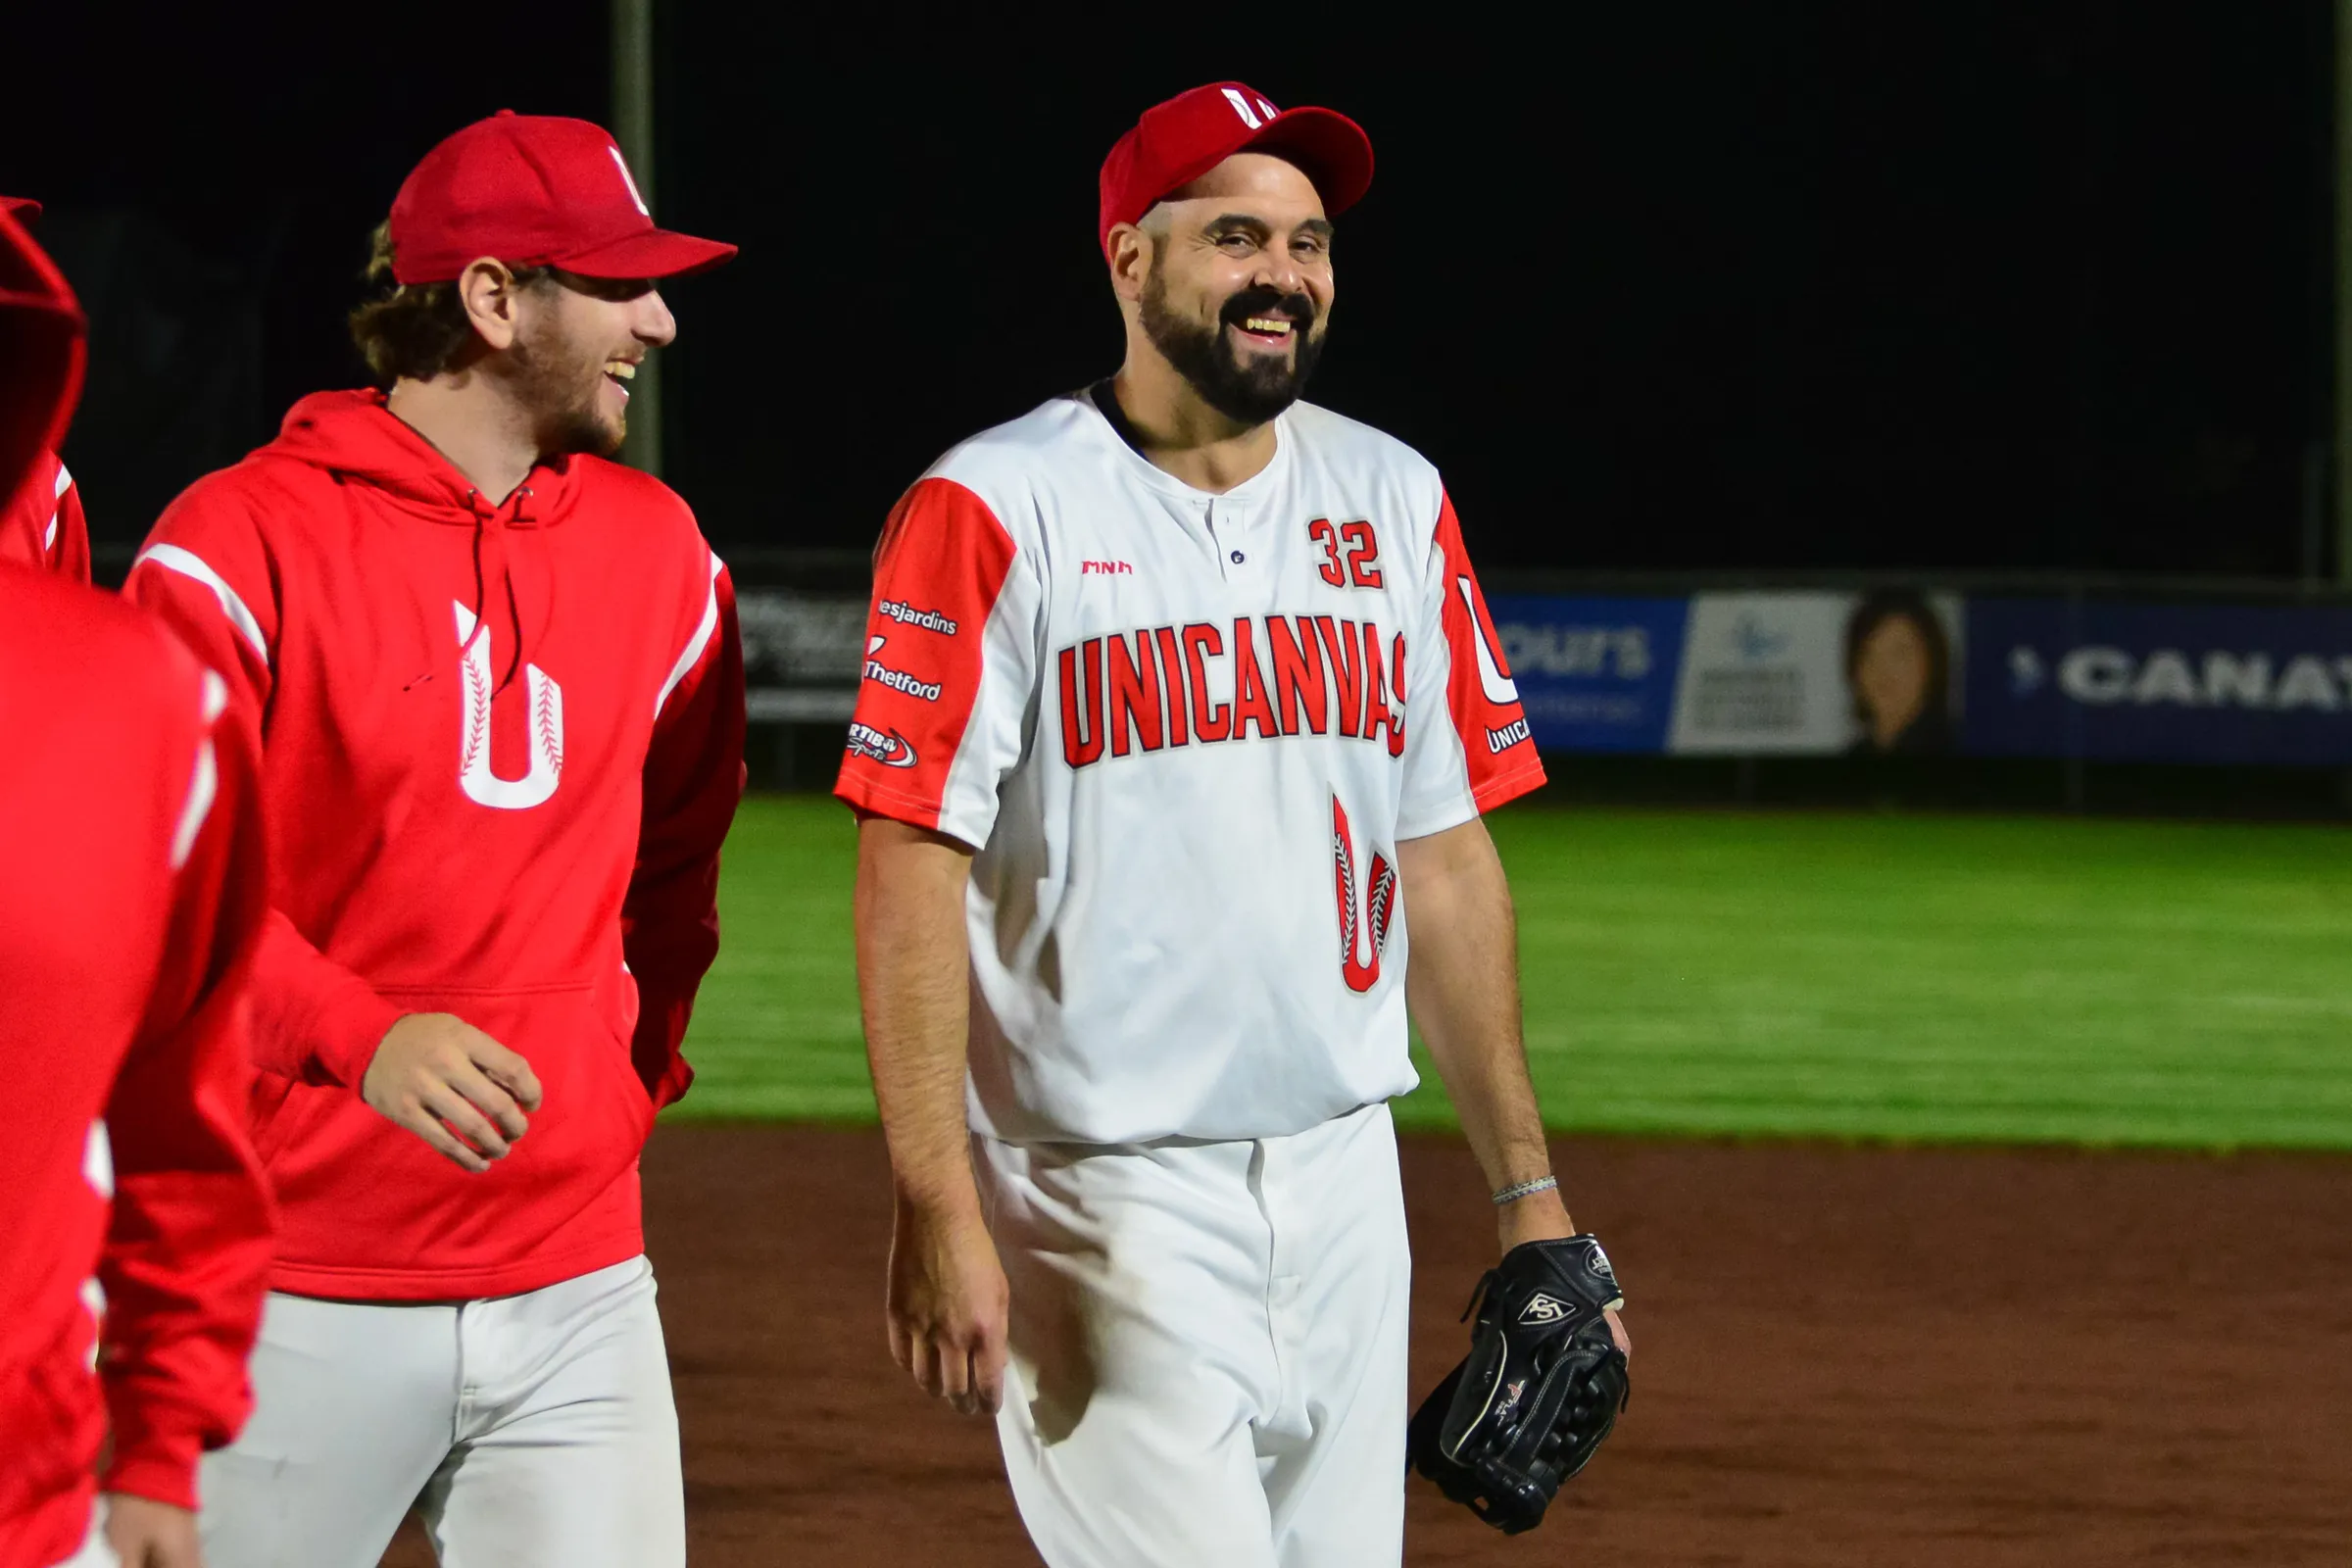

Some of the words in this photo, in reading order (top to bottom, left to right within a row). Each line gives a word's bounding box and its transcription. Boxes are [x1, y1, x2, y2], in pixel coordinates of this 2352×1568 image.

[1307, 517, 1385, 590] 32
[878, 600, 958, 636] esjardins
[864, 660, 942, 702] Thetford
[2061, 646, 2352, 711] CANA
